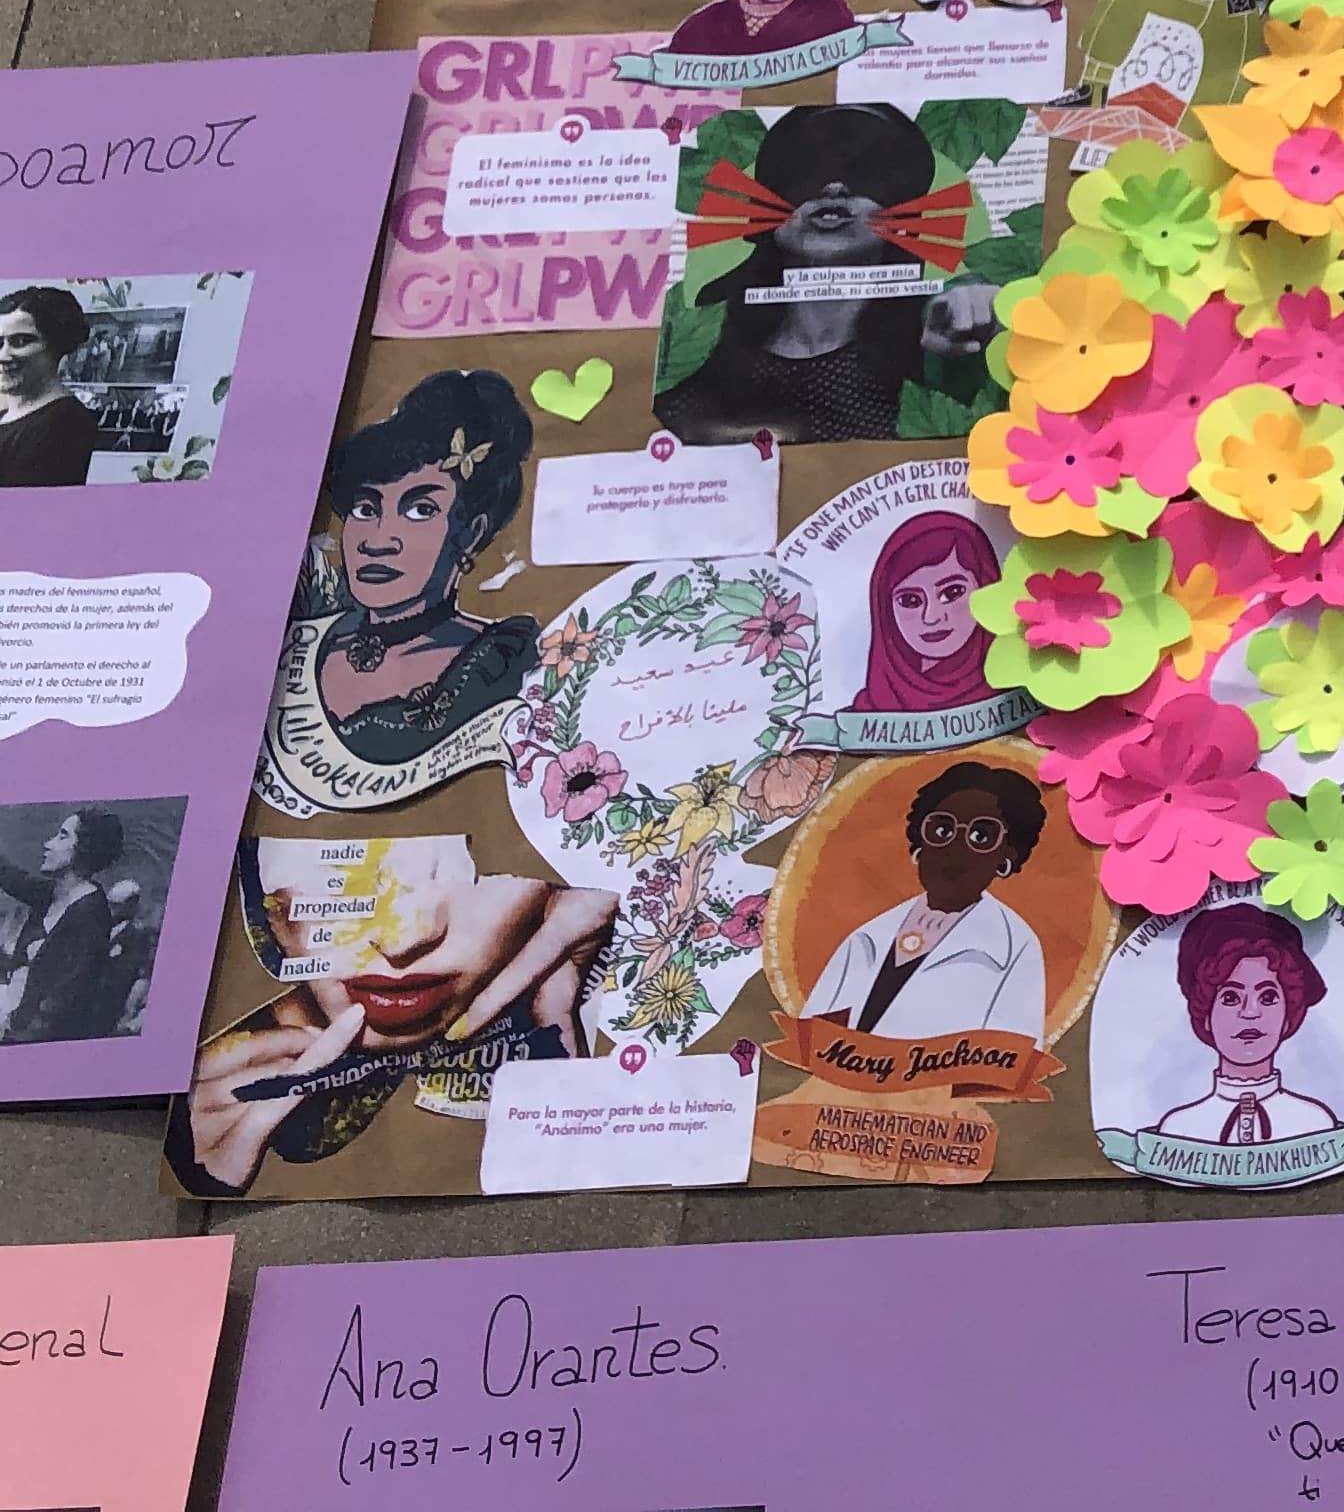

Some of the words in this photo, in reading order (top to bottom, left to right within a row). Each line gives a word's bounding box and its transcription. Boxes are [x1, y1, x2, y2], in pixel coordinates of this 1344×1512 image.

[675, 55, 748, 81] VICTORIA
[754, 52, 807, 78] SANTA
[810, 39, 852, 67] CRUZ
[859, 715, 936, 744] MALALA
[321, 845, 364, 859] nadie
[328, 878, 344, 888] es
[294, 898, 375, 917] propiedad
[313, 928, 332, 942] de
[285, 959, 330, 975] nadie
[818, 1039, 894, 1081] Mary
[903, 1040, 1018, 1080] Jackson
[815, 1106, 949, 1141] MATHEMATICIAN
[954, 1121, 989, 1144] AND
[809, 1129, 893, 1157] AEROSPACE
[900, 1139, 981, 1165] ENGINEER
[1149, 1142, 1241, 1175] EMMELINE
[1247, 1139, 1339, 1176] PANKHURST
[1146, 1266, 1336, 1345] Teresa
[320, 1305, 439, 1410] Ana
